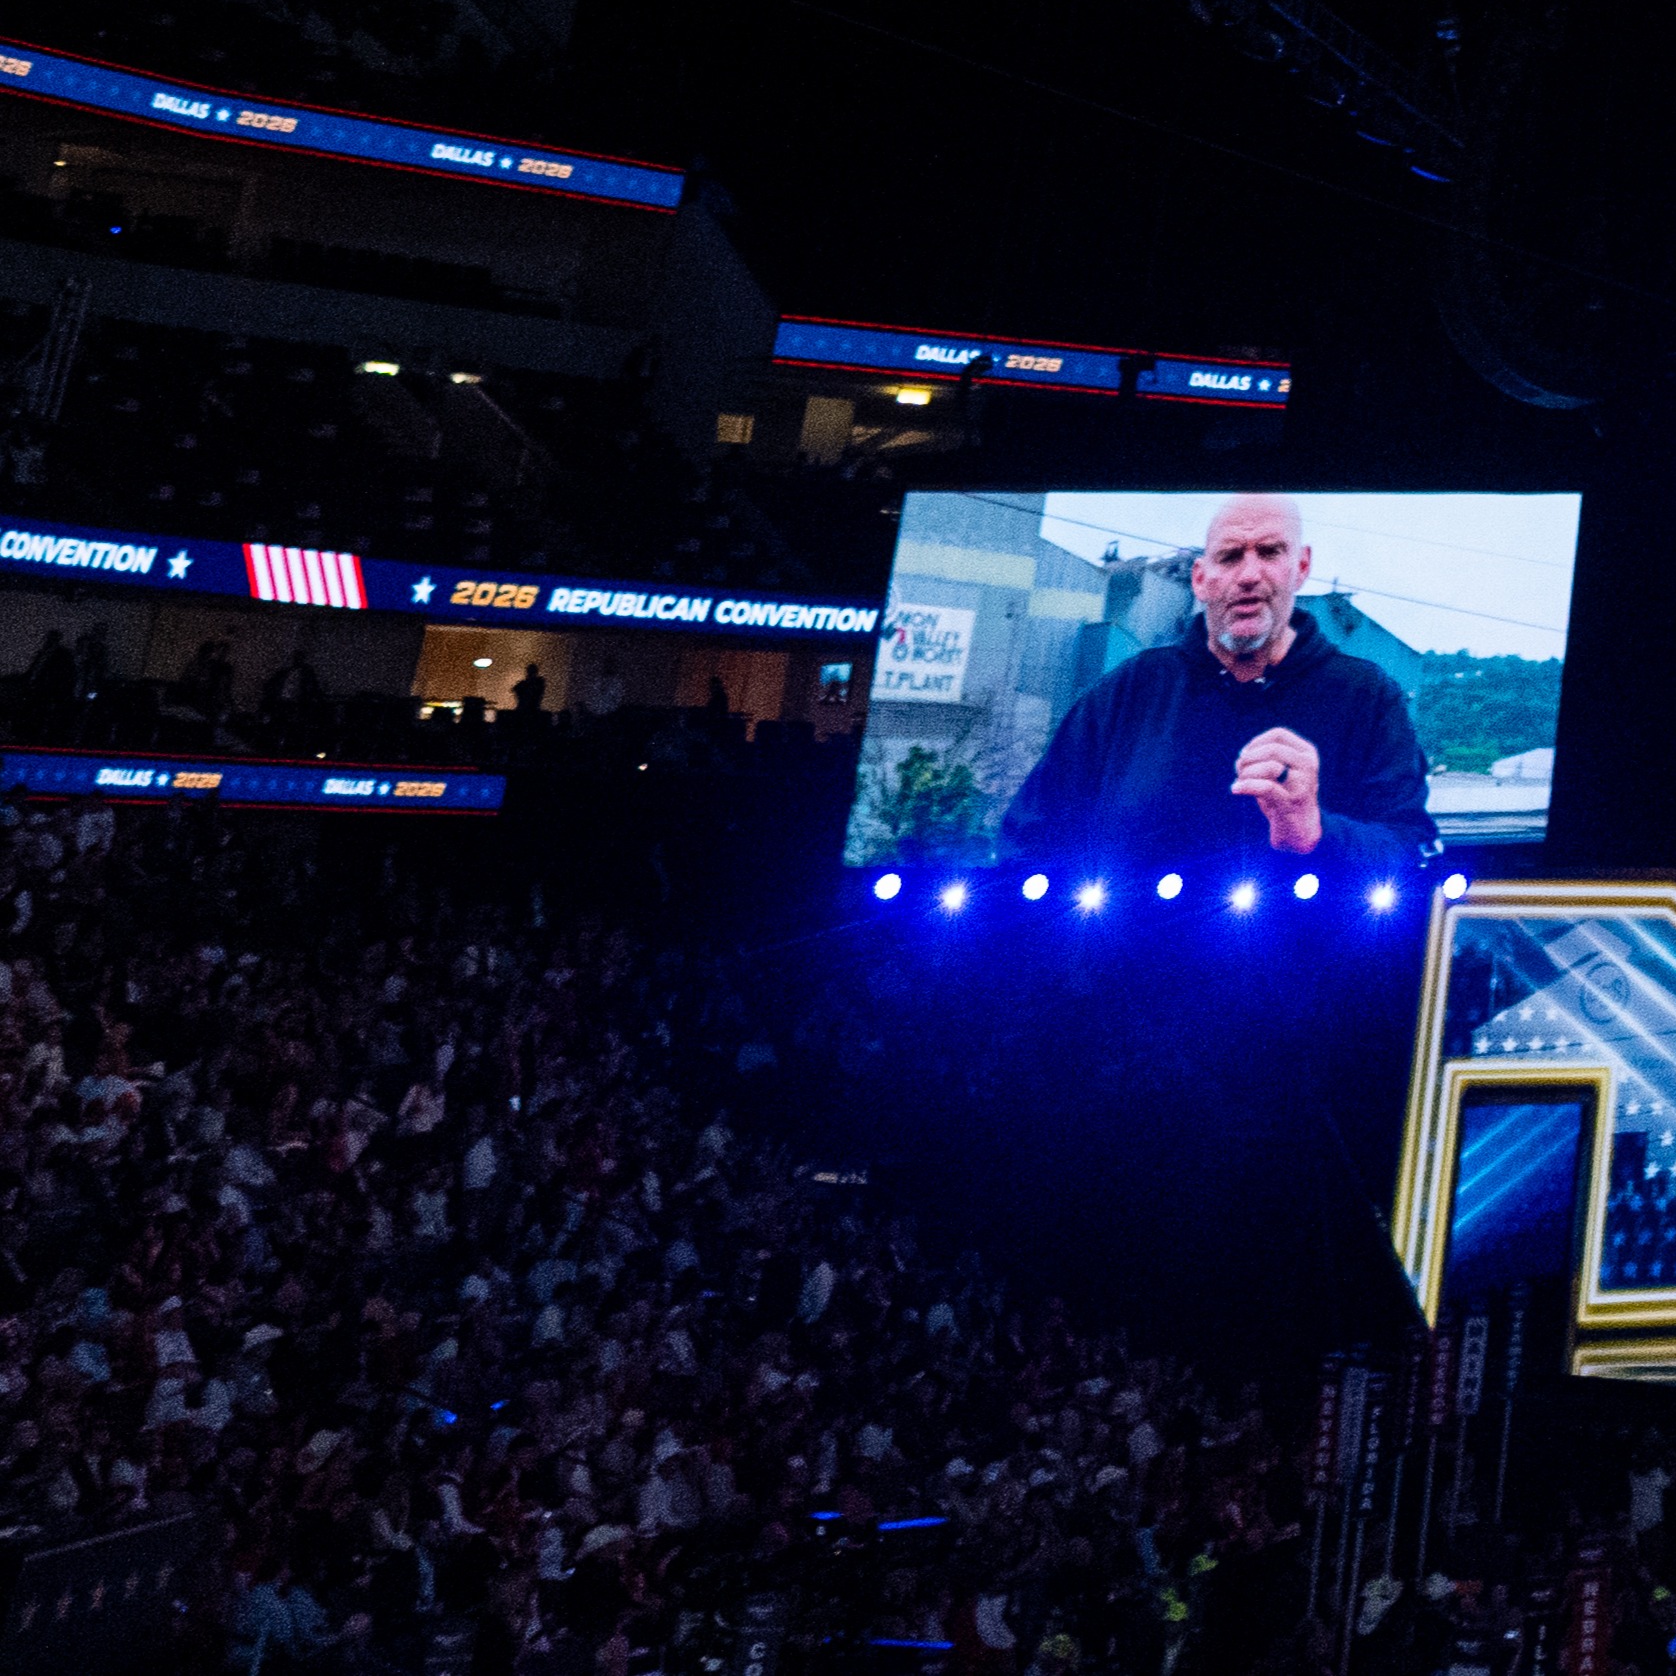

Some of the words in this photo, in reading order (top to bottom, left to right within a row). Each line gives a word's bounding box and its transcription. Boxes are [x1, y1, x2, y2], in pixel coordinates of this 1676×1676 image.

[152, 93, 212, 119] DALLAS
[431, 143, 496, 168] DALLAS
[1188, 370, 1252, 391] DALLAS
[0, 529, 157, 575] CONVENTION
[449, 579, 542, 611] 2026
[546, 587, 710, 624] REPUBLICAN
[713, 598, 881, 635] CONVENTION
[96, 767, 153, 790] DALLAS
[322, 777, 374, 797] DALLAS
